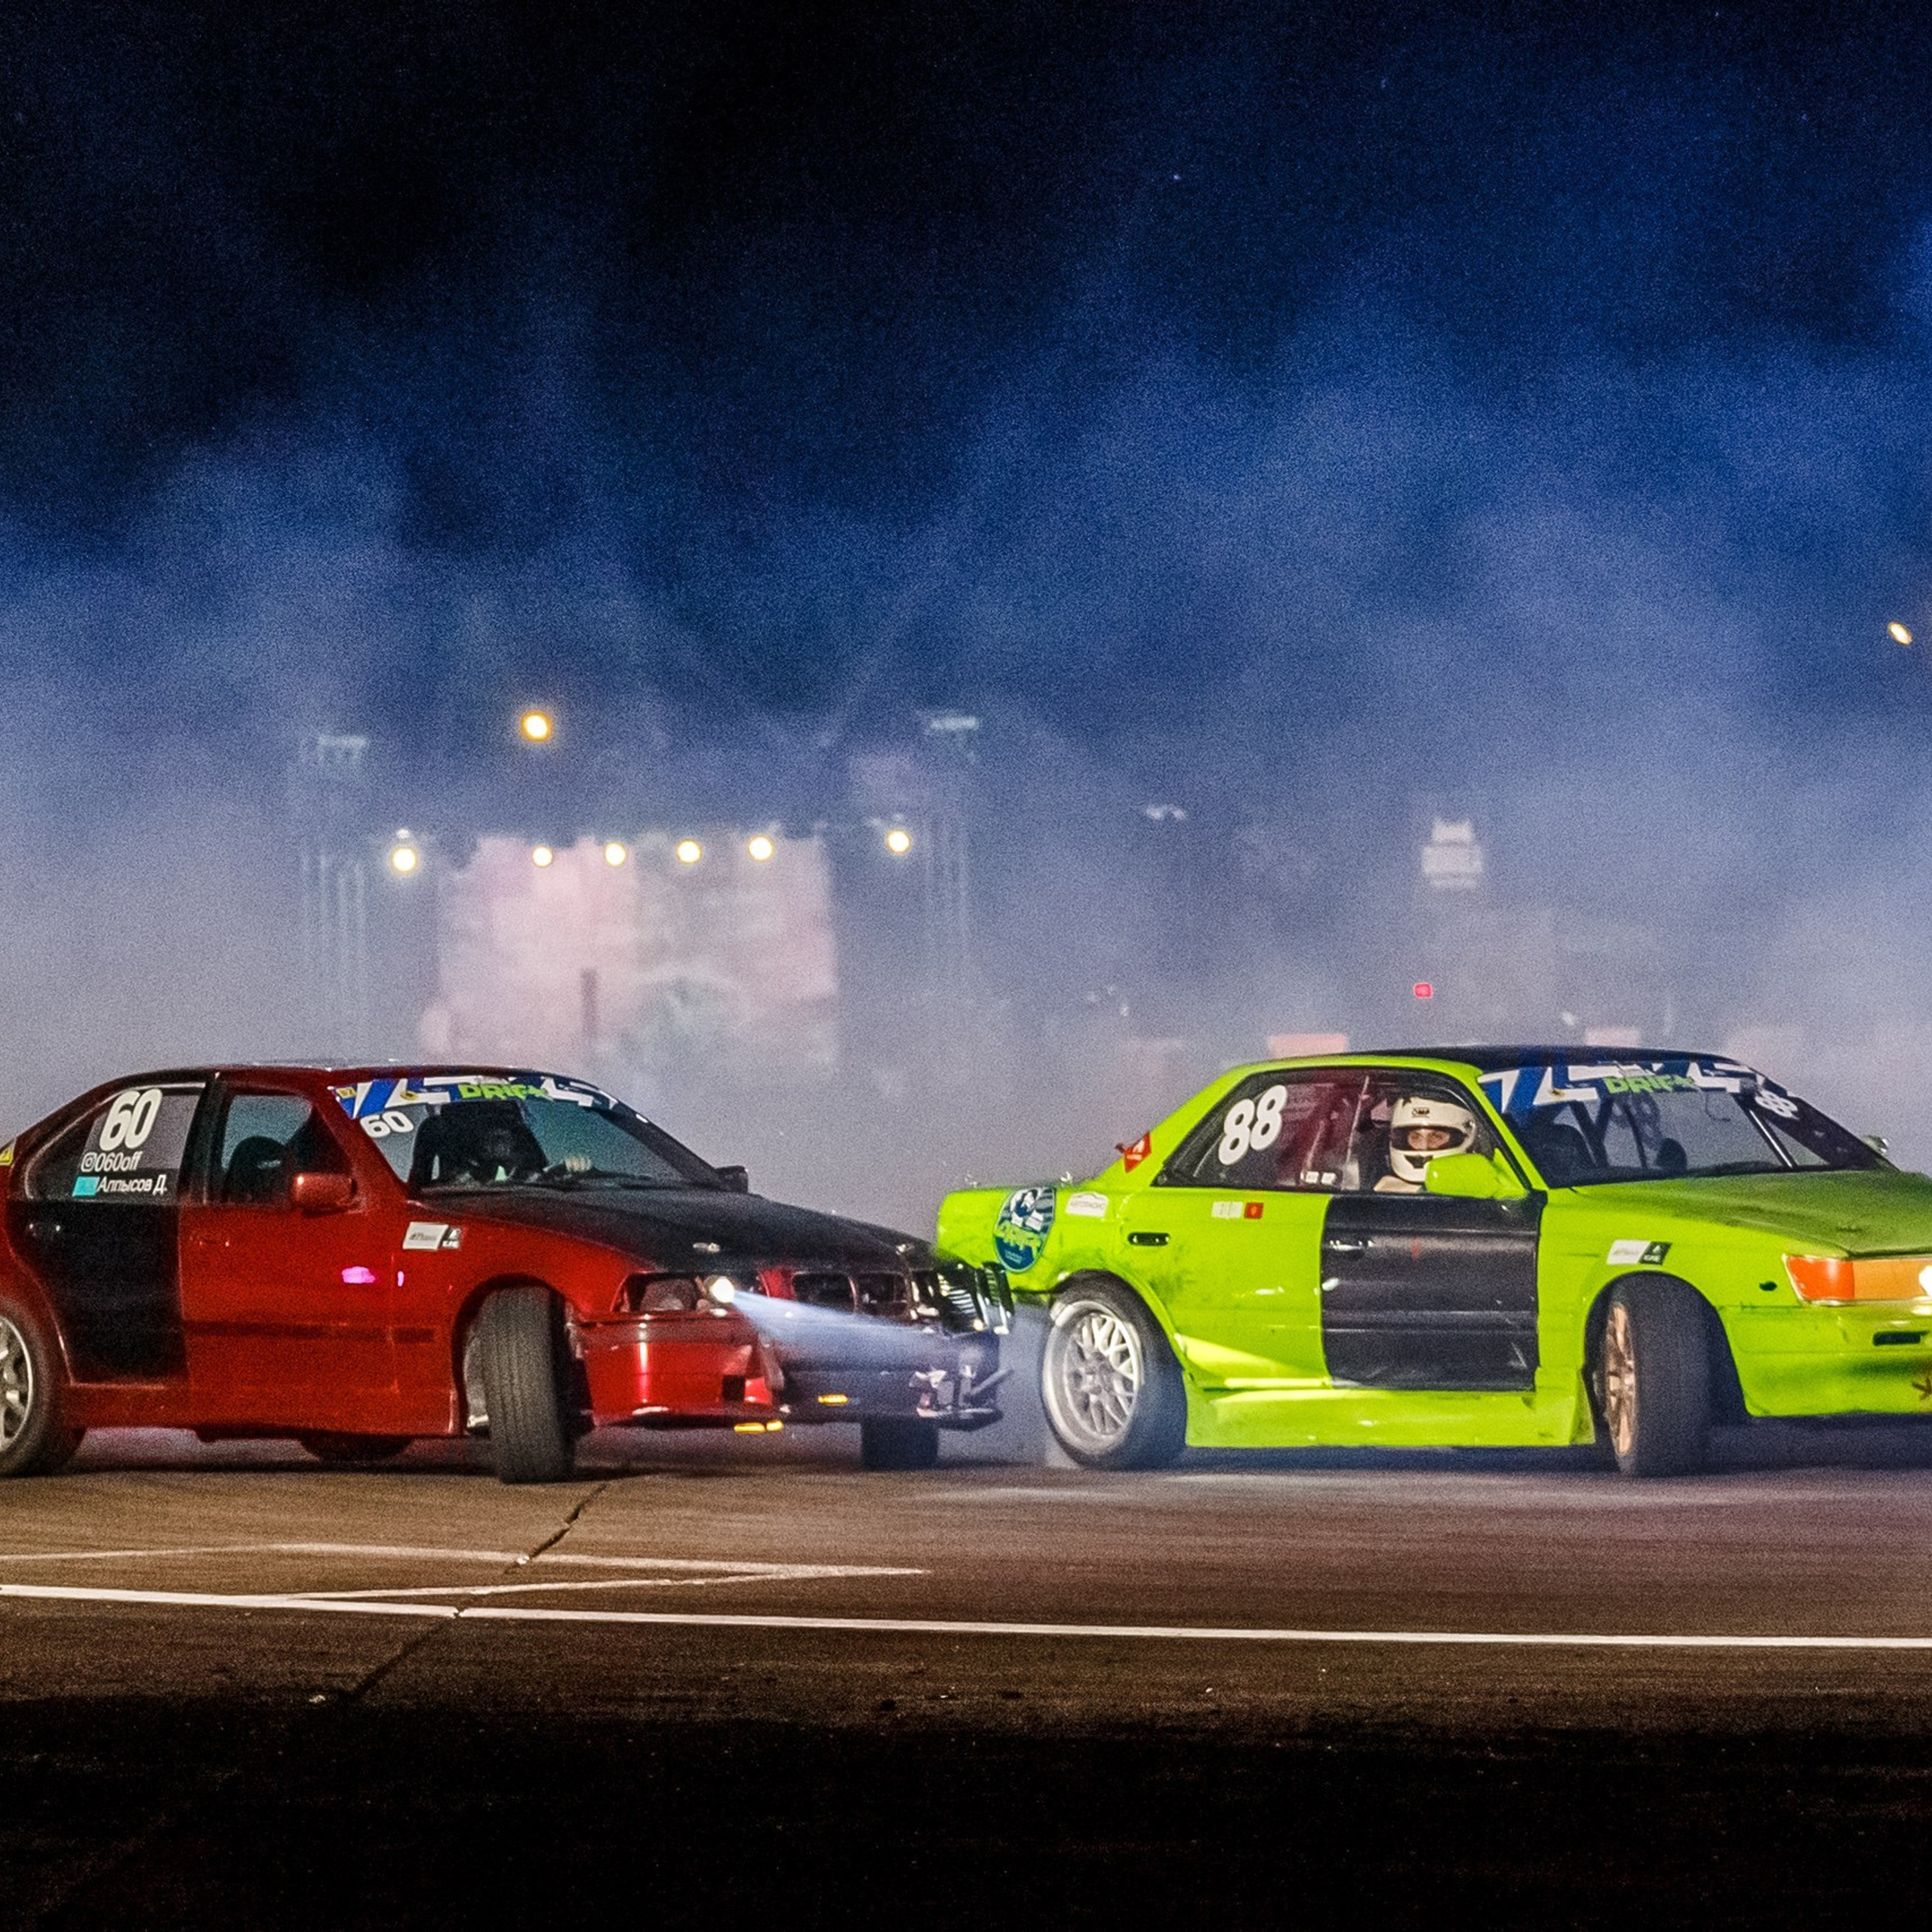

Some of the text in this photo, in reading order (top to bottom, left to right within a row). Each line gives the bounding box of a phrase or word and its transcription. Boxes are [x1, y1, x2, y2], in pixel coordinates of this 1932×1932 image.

[99, 1088, 163, 1152] 60
[359, 1111, 414, 1138] 60
[1218, 1084, 1288, 1165] 88
[81, 1151, 143, 1172] @060off
